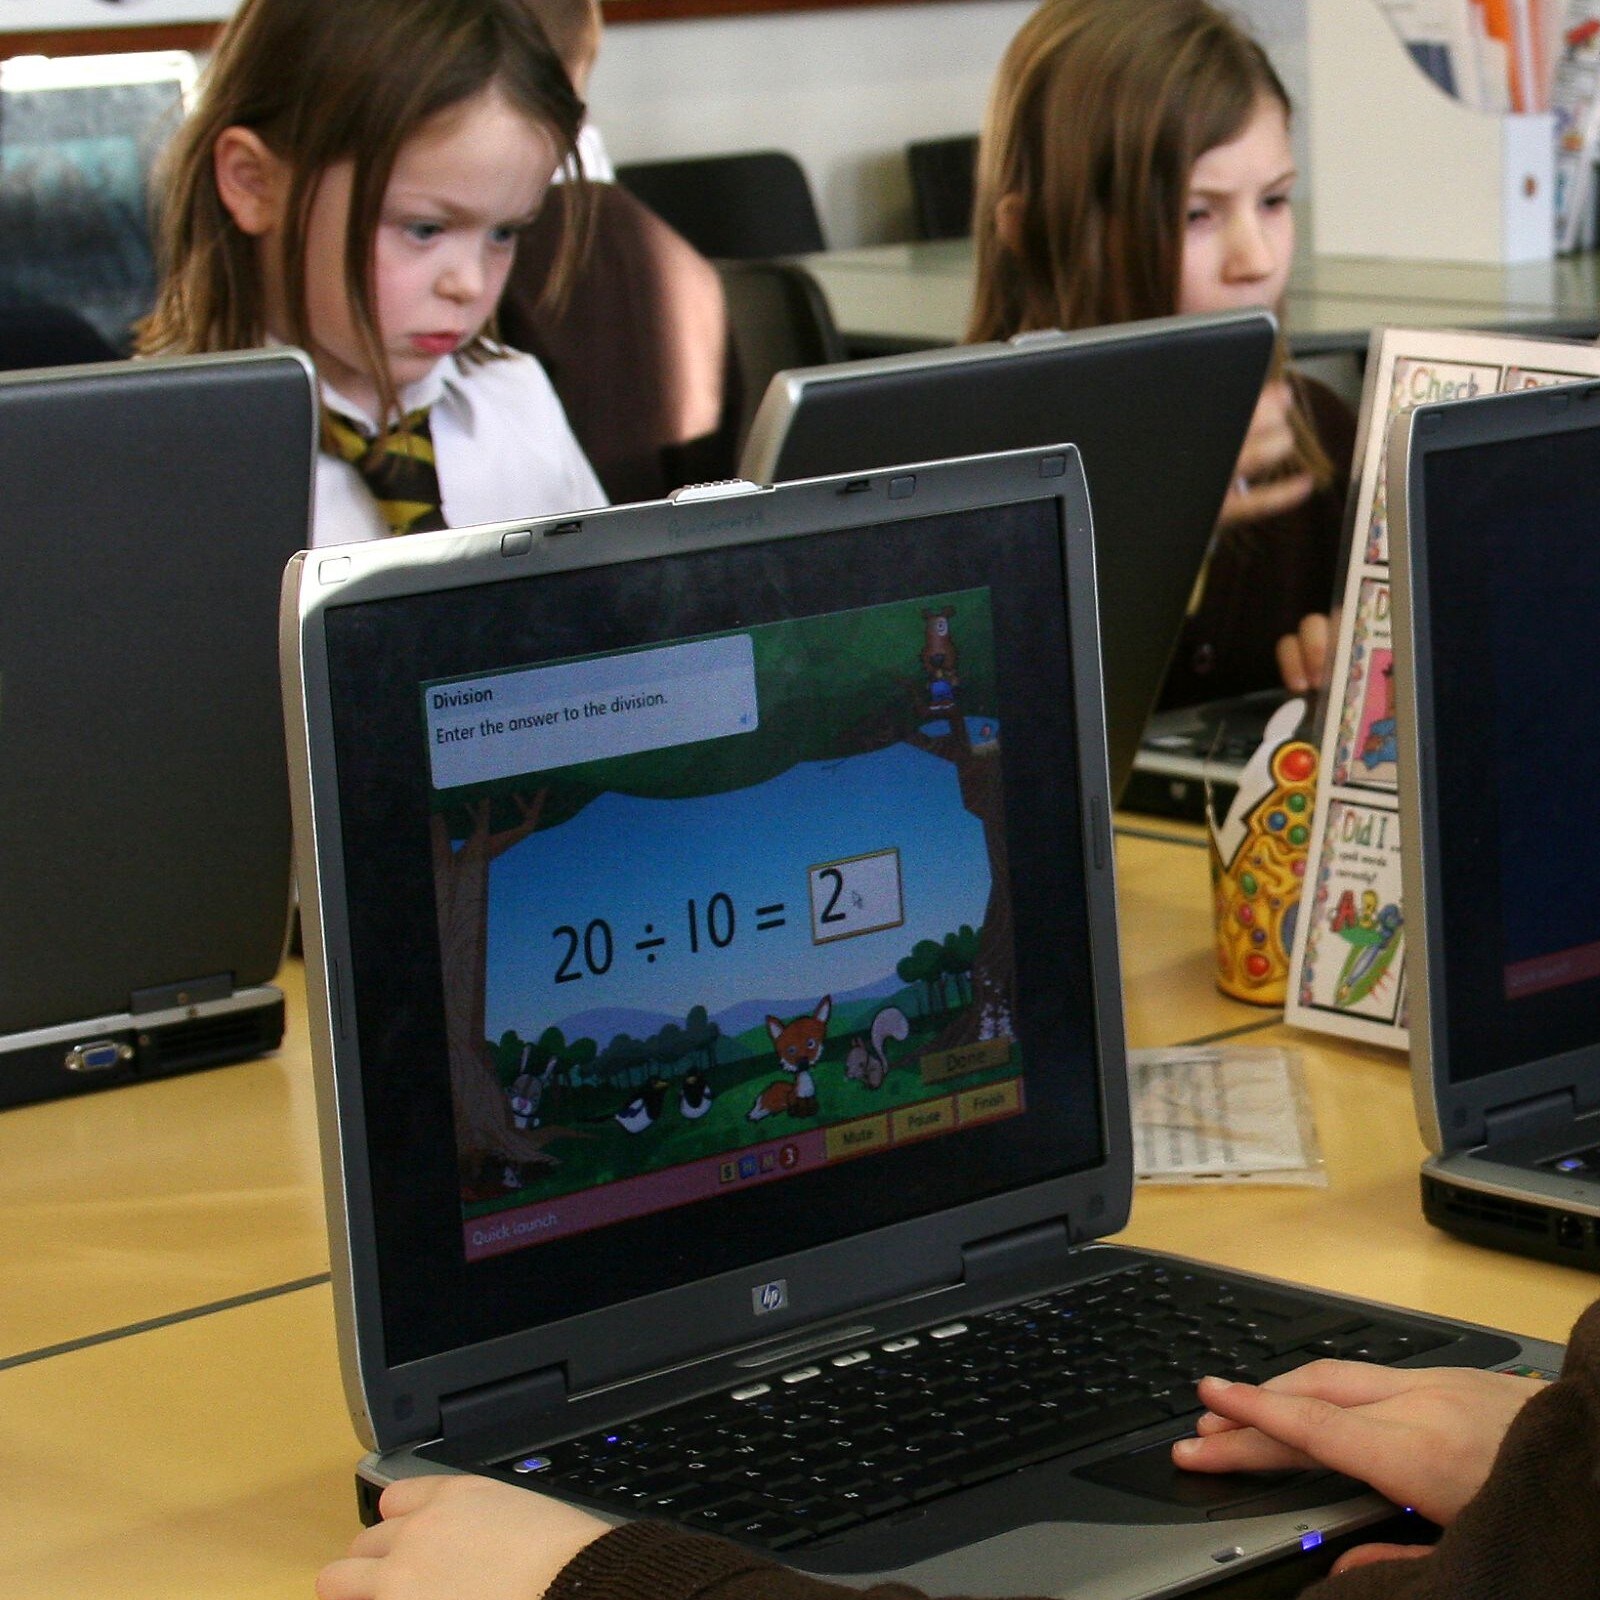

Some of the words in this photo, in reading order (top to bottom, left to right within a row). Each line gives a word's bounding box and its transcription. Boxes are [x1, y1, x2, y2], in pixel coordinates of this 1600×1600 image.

[433, 687, 493, 711] Division
[436, 724, 474, 745] Enter
[480, 718, 504, 737] the
[508, 711, 560, 732] answer
[564, 706, 580, 721] to
[583, 700, 607, 719] the
[611, 690, 669, 714] division.
[1342, 809, 1374, 847] Did
[552, 918, 614, 984] 20
[688, 892, 736, 953] 10
[818, 867, 848, 924] 2
[843, 1128, 874, 1145] Mute
[472, 1225, 511, 1246] Quick
[512, 1212, 558, 1236] launch
